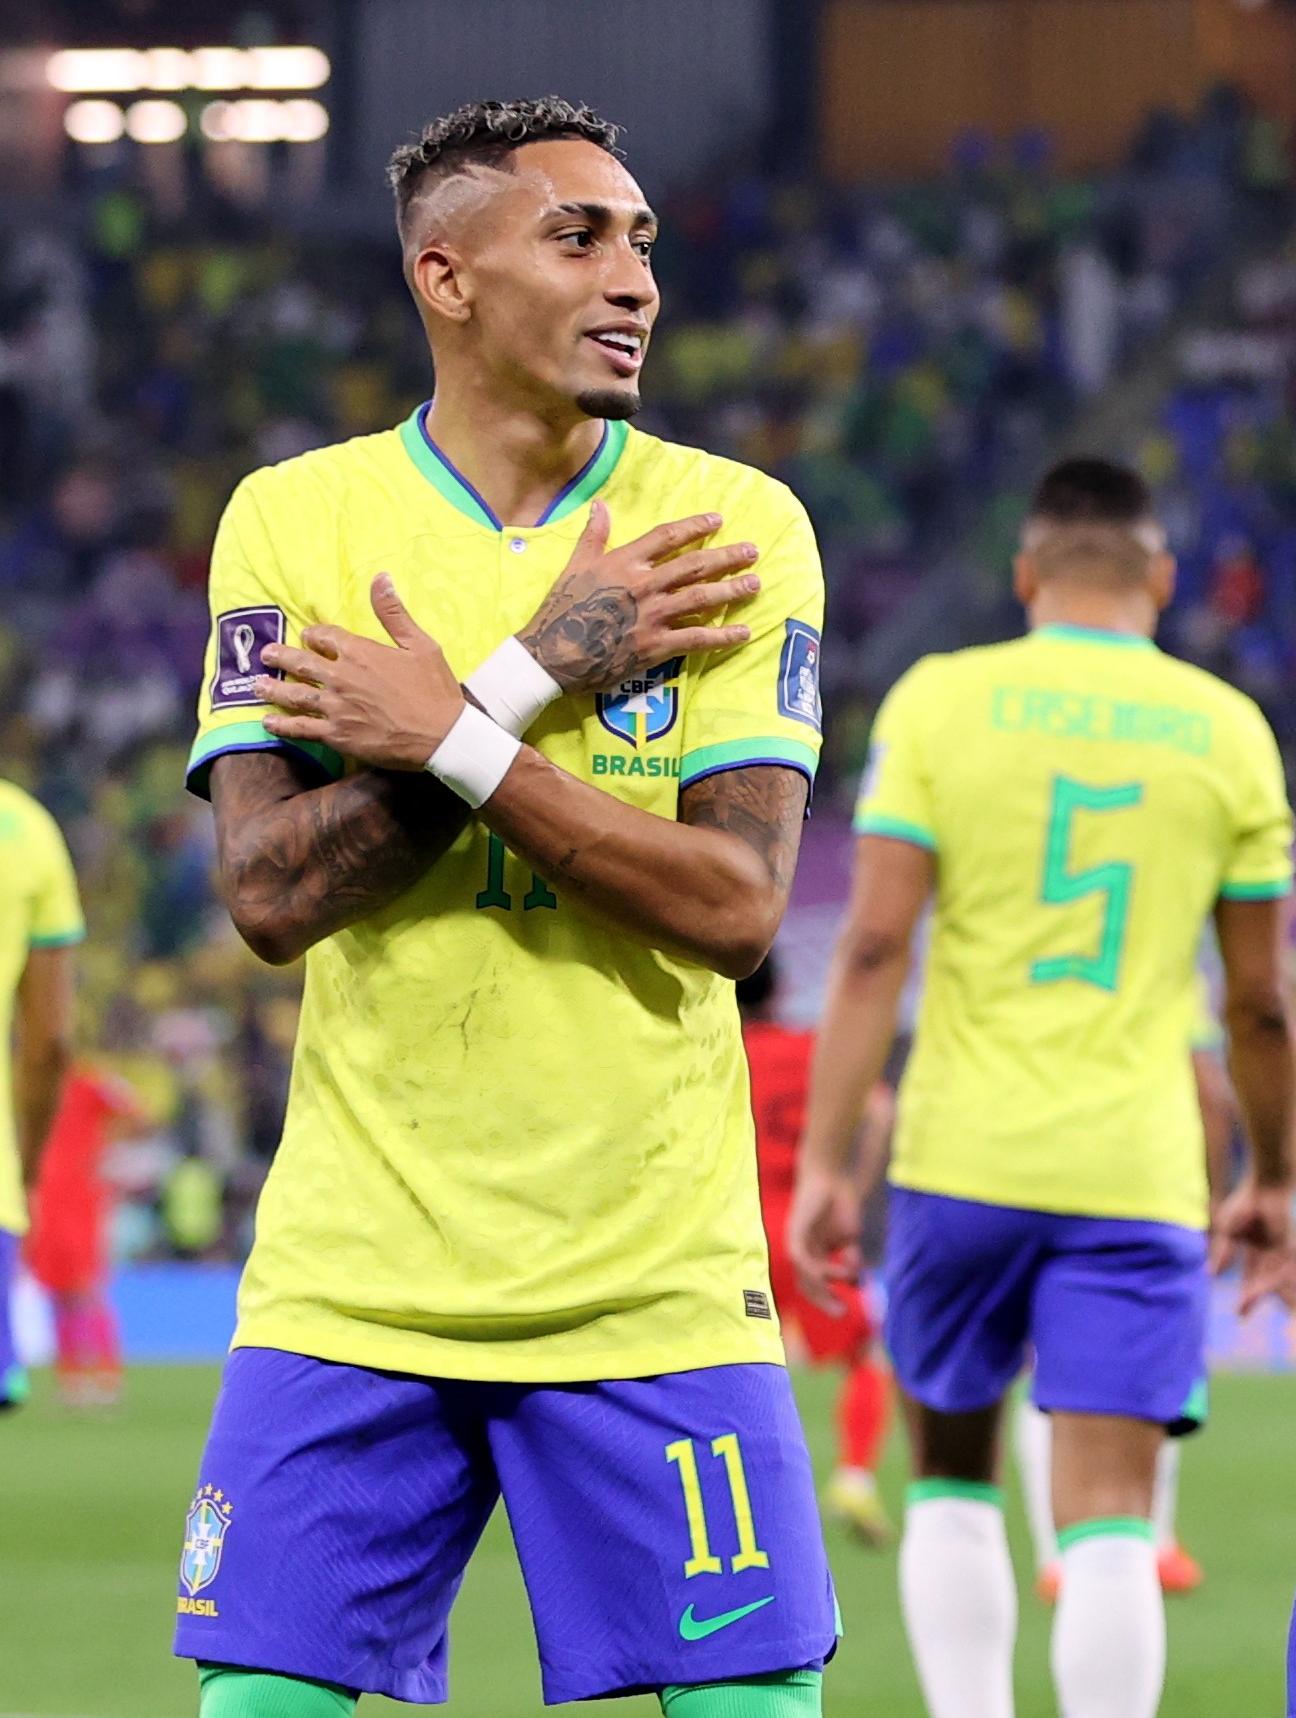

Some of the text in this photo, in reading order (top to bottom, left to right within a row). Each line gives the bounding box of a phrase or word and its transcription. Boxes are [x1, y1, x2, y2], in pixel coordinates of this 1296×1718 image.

[620, 680, 655, 693] CBF
[591, 754, 681, 778] BRASIL
[1030, 774, 1144, 992] 5
[664, 1432, 771, 1580] 11
